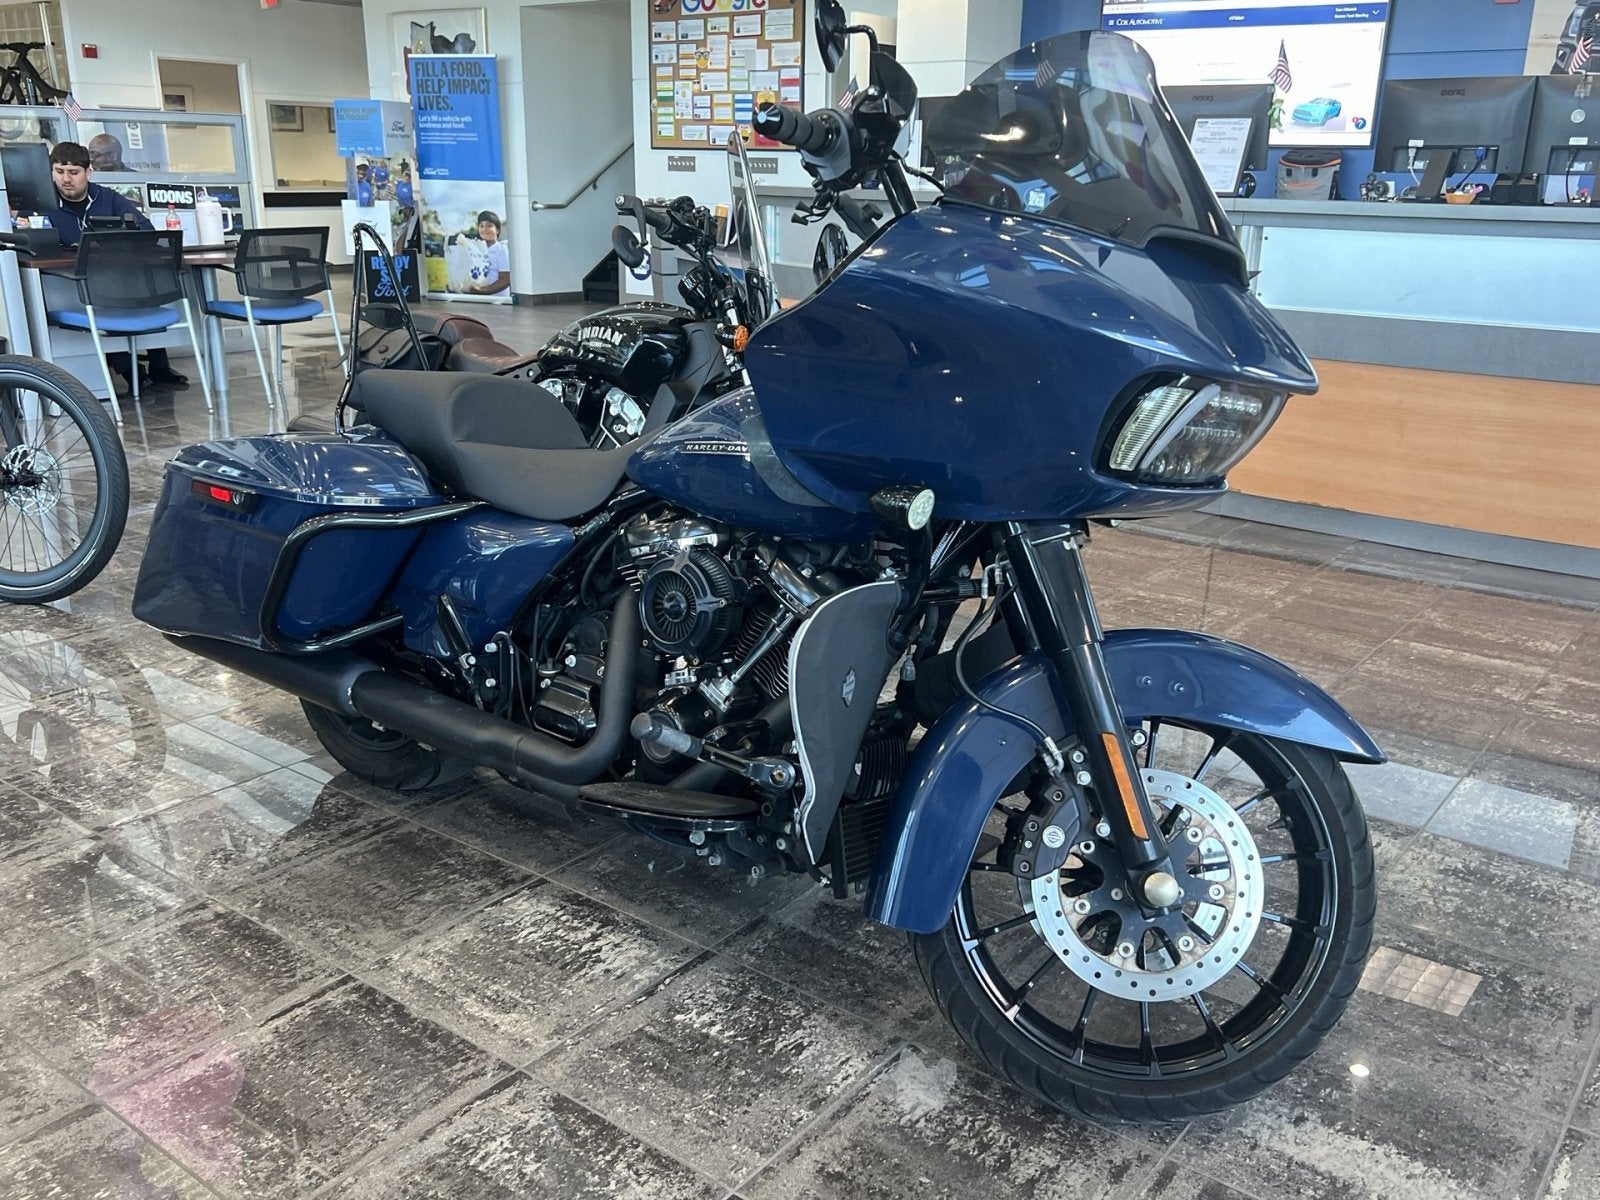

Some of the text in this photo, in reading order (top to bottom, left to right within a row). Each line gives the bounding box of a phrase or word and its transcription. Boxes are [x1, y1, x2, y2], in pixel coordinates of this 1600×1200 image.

[415, 62, 486, 77] FILL A FORD.
[416, 79, 492, 95] HELP IMPACT
[417, 95, 454, 111] LIVES.
[149, 189, 194, 205] KOONS
[370, 255, 410, 270] REDY
[380, 269, 402, 283] ST
[374, 282, 413, 298] Fod
[577, 325, 624, 346] INDIAN
